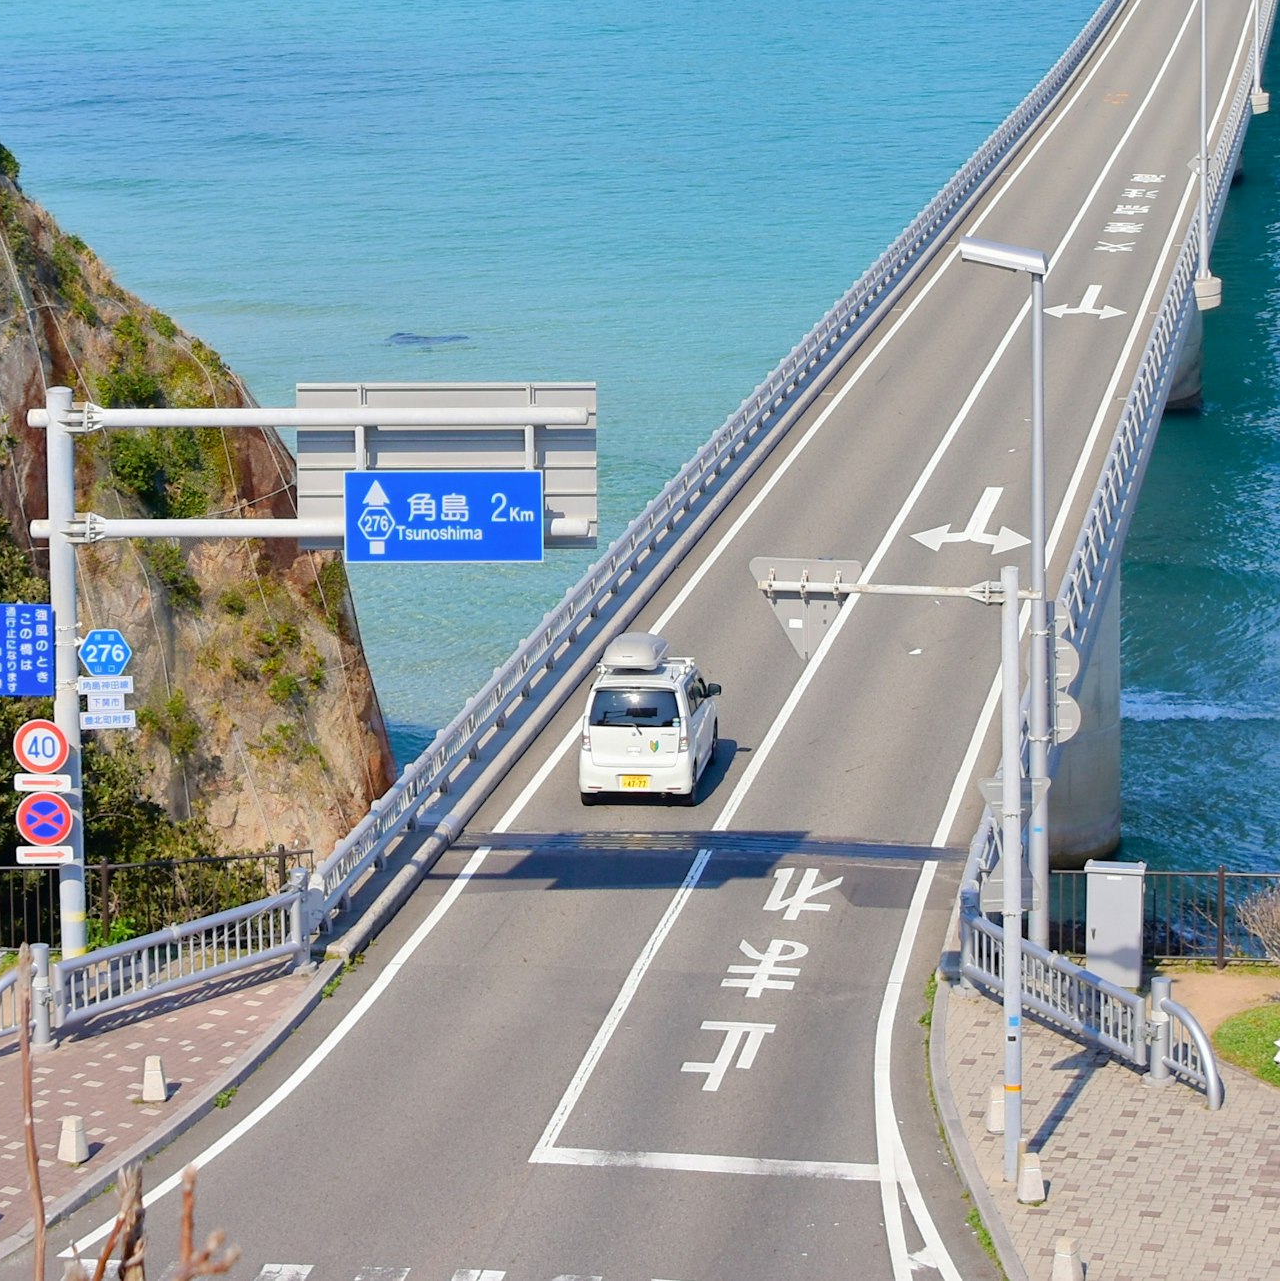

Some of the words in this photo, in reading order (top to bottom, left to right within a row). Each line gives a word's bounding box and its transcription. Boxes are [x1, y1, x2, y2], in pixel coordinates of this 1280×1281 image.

[1094, 173, 1166, 252] 交差点注意
[407, 492, 469, 522] 角島
[364, 515, 389, 532] 276
[396, 525, 483, 541] Tsunoshima
[5, 606, 17, 693] 通行止になります
[19, 613, 33, 671] この橋は
[35, 608, 49, 684] 強風のとき
[85, 644, 125, 663] 276
[94, 665, 116, 673] 山口
[82, 680, 129, 691] 角島神田線
[92, 698, 120, 707] 下関市
[27, 736, 56, 758] 40
[680, 867, 844, 1092] 止まれ
